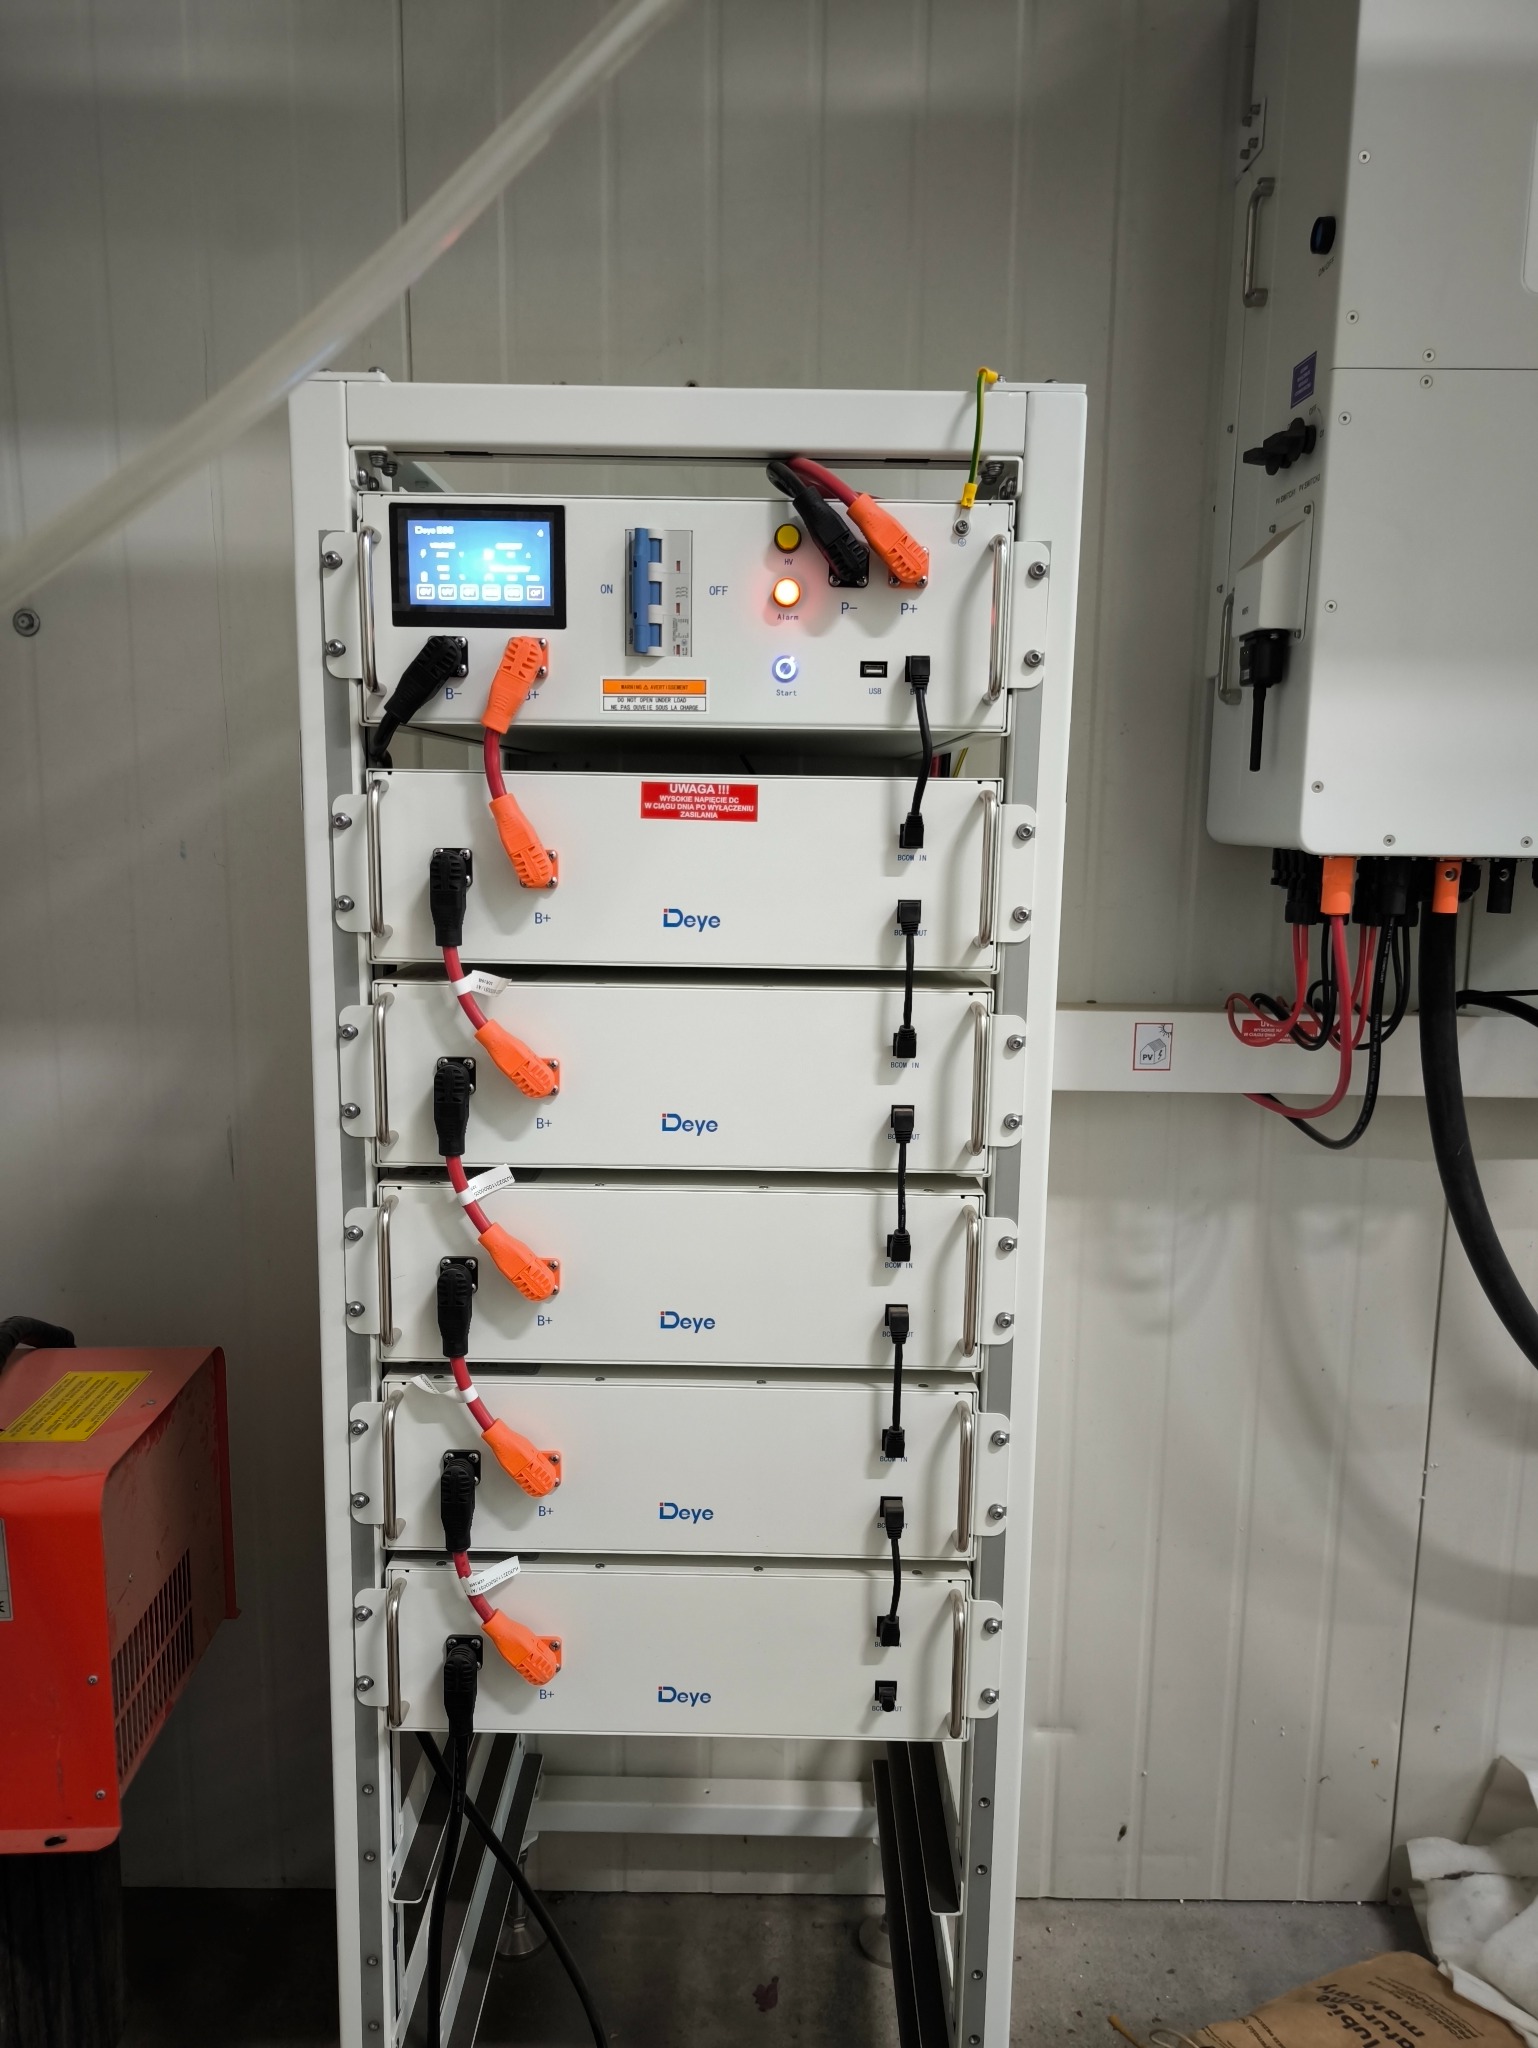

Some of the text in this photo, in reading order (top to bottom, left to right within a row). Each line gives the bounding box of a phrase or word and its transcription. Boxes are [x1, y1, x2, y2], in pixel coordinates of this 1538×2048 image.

[784, 558, 794, 566] HV
[600, 584, 613, 594] ON
[709, 585, 728, 596] OFF
[841, 602, 858, 615] P-
[900, 602, 918, 615] P+
[777, 613, 799, 621] Alarm
[445, 687, 462, 700] B-
[776, 689, 797, 697] Start
[868, 687, 882, 695] USB
[669, 783, 730, 795] UWAGA !!!
[659, 795, 693, 803] WYSOKIE
[694, 796, 728, 805] NAPIĘCIE
[653, 802, 676, 811] CIĄGU
[677, 803, 695, 811] DNIA
[707, 804, 755, 813] WYŁĄCZENIU
[680, 811, 719, 819] ZASILANIA
[919, 854, 927, 862] IN
[534, 911, 552, 925] B+
[663, 908, 721, 933] Deye
[536, 1117, 553, 1130] B+
[662, 1113, 719, 1137] Deye
[537, 1314, 554, 1327] B+
[660, 1311, 716, 1334] Deye
[538, 1505, 555, 1517] B+
[659, 1502, 715, 1525] Deye
[539, 1688, 555, 1700] B+
[658, 1686, 712, 1708] Deye
